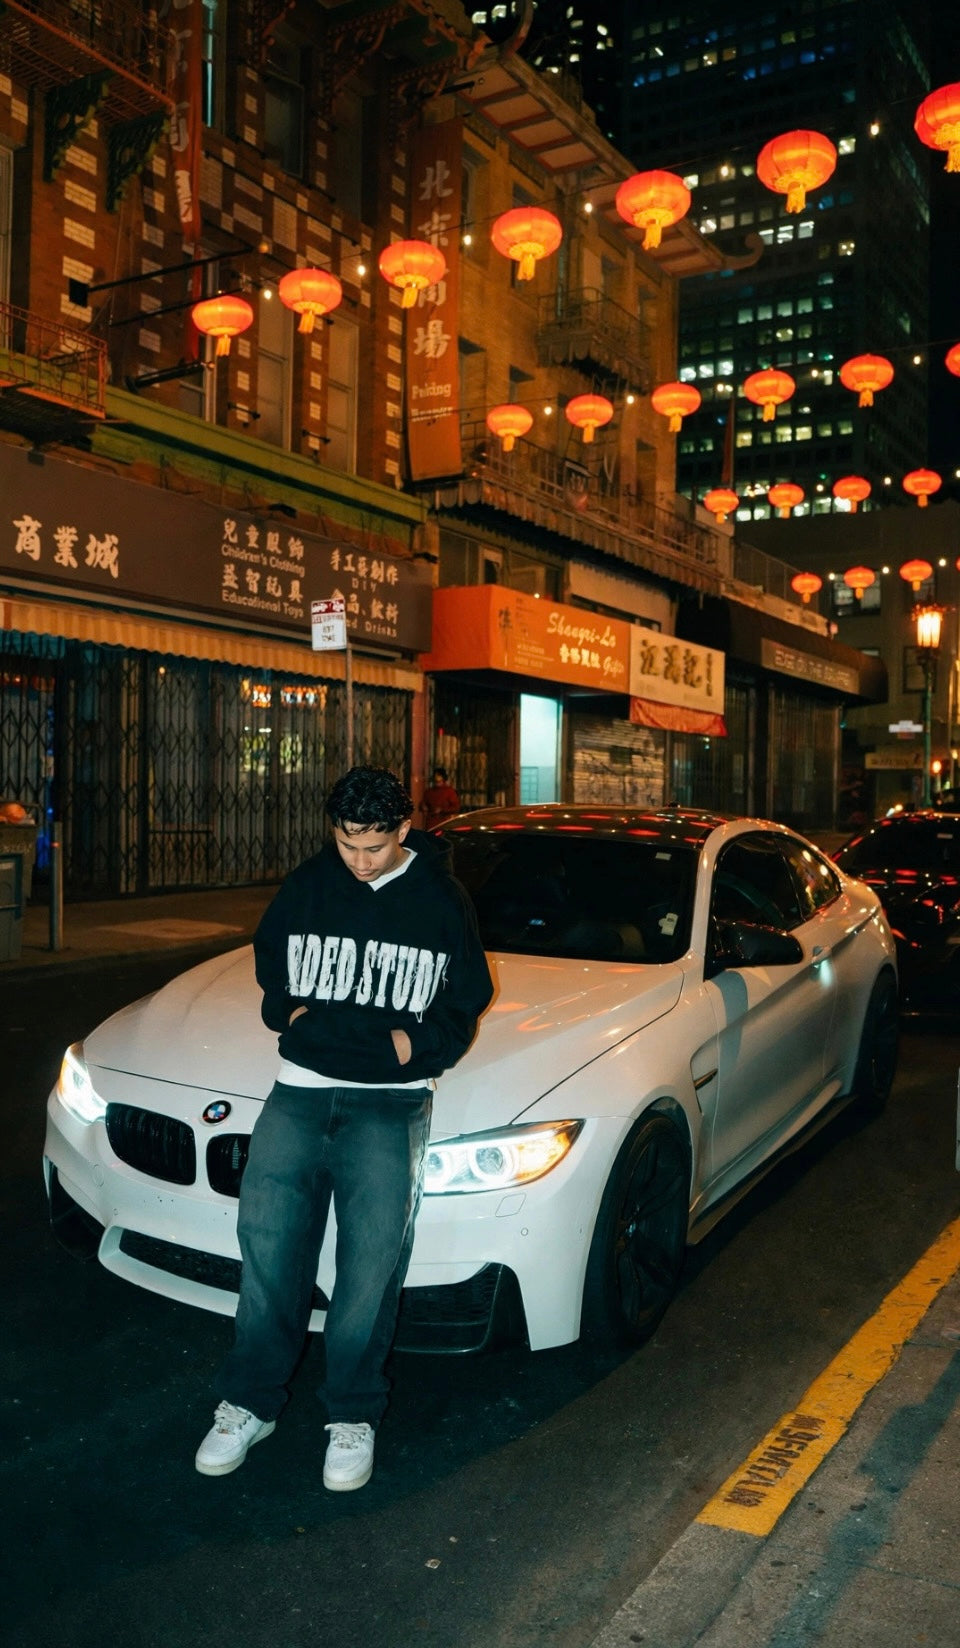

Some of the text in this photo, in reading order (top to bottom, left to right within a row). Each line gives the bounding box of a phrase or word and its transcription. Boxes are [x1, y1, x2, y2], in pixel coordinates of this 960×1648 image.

[12, 514, 120, 579] 商業城
[223, 518, 305, 561] 兒童服飾
[221, 544, 306, 578] Children's Clothing
[221, 563, 304, 603] 益智玩具
[221, 589, 281, 613] Educational
[282, 602, 304, 619] Toys
[365, 621, 397, 638] Drinks
[546, 612, 617, 648] Shangri-La
